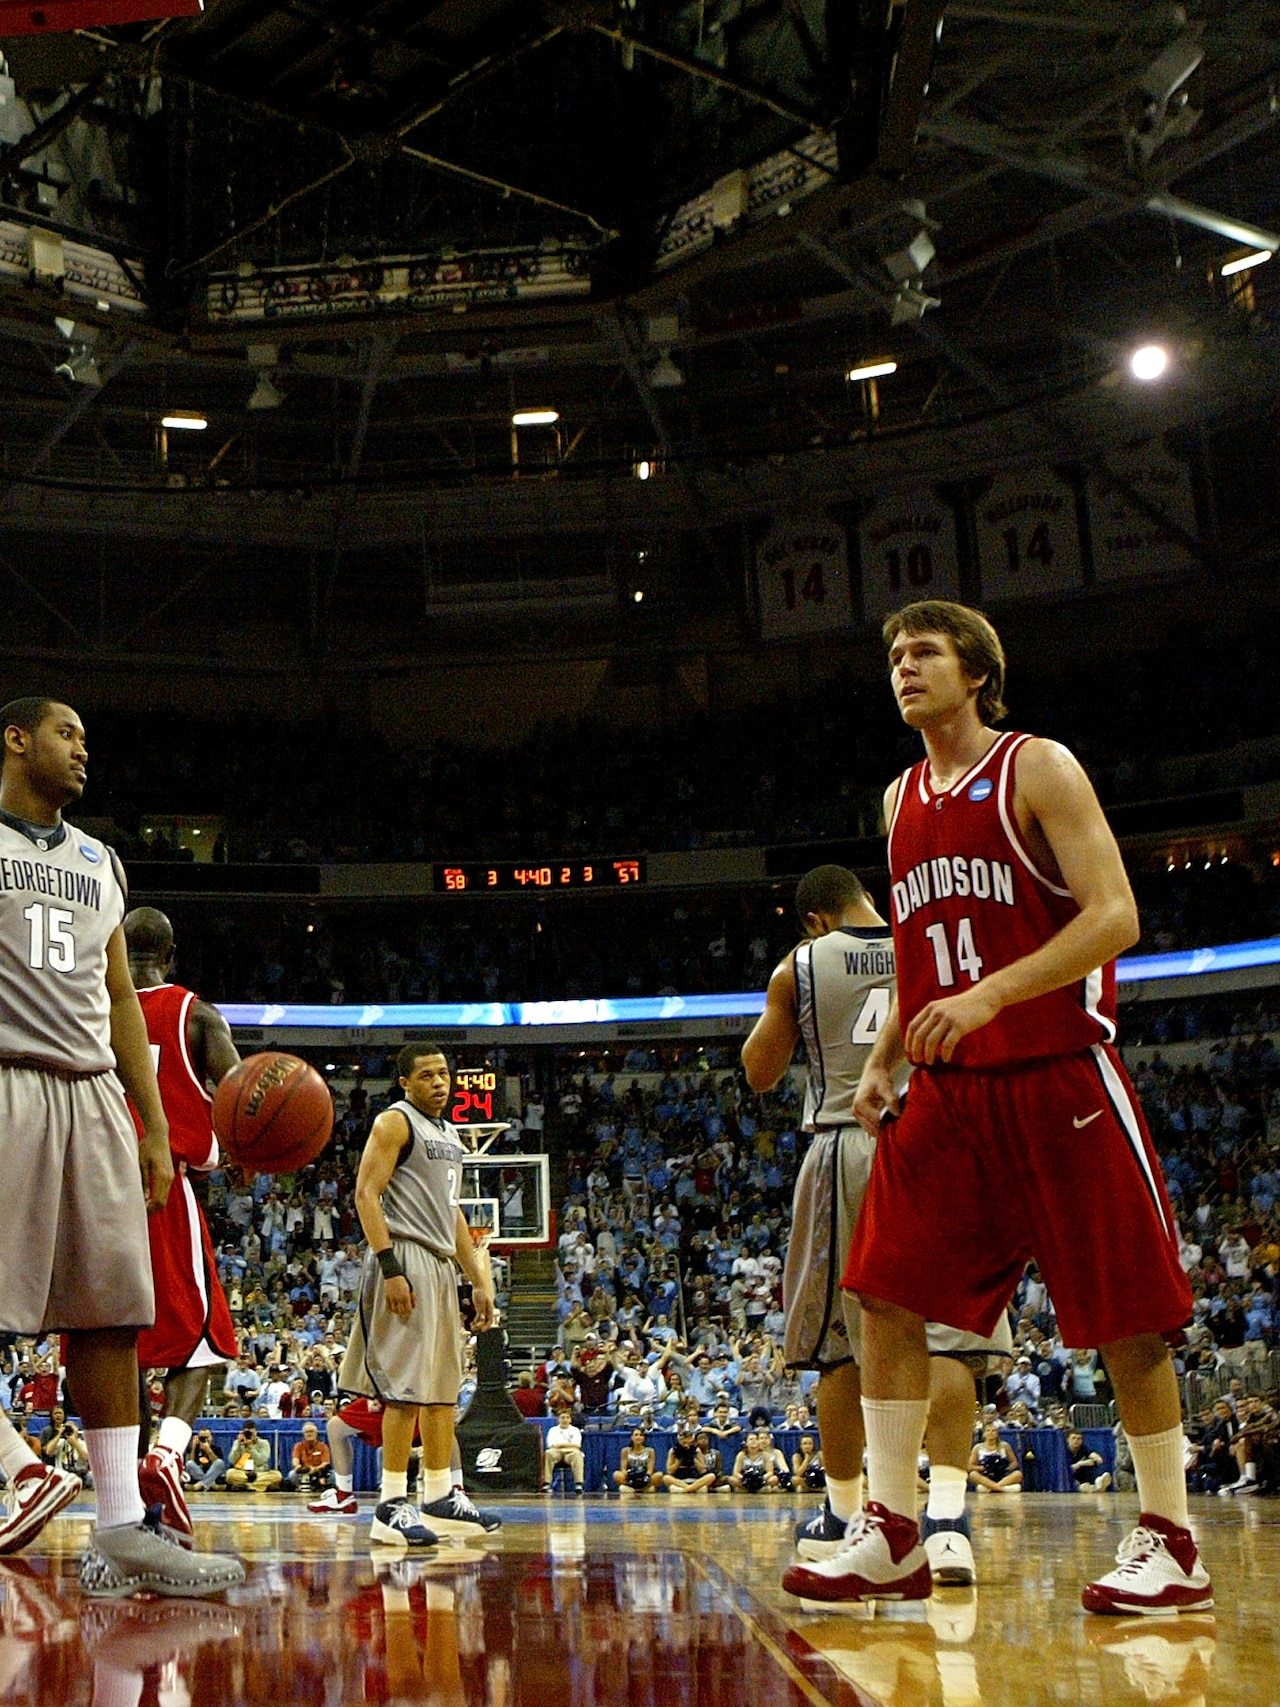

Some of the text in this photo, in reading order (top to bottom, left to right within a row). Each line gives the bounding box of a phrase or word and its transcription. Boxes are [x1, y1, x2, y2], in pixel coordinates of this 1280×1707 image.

[886, 543, 932, 591] 10
[1002, 522, 1053, 571] 14
[782, 564, 825, 610] 14
[446, 866, 639, 890] 58 3 4:40 2 3 57
[892, 855, 1015, 924] DAVIDSON
[23, 901, 76, 973] 15
[925, 917, 984, 987] 14
[844, 951, 896, 976] WRIGH
[851, 986, 891, 1045] 4
[456, 1072, 496, 1090] 4:40
[452, 1091, 493, 1123] 24
